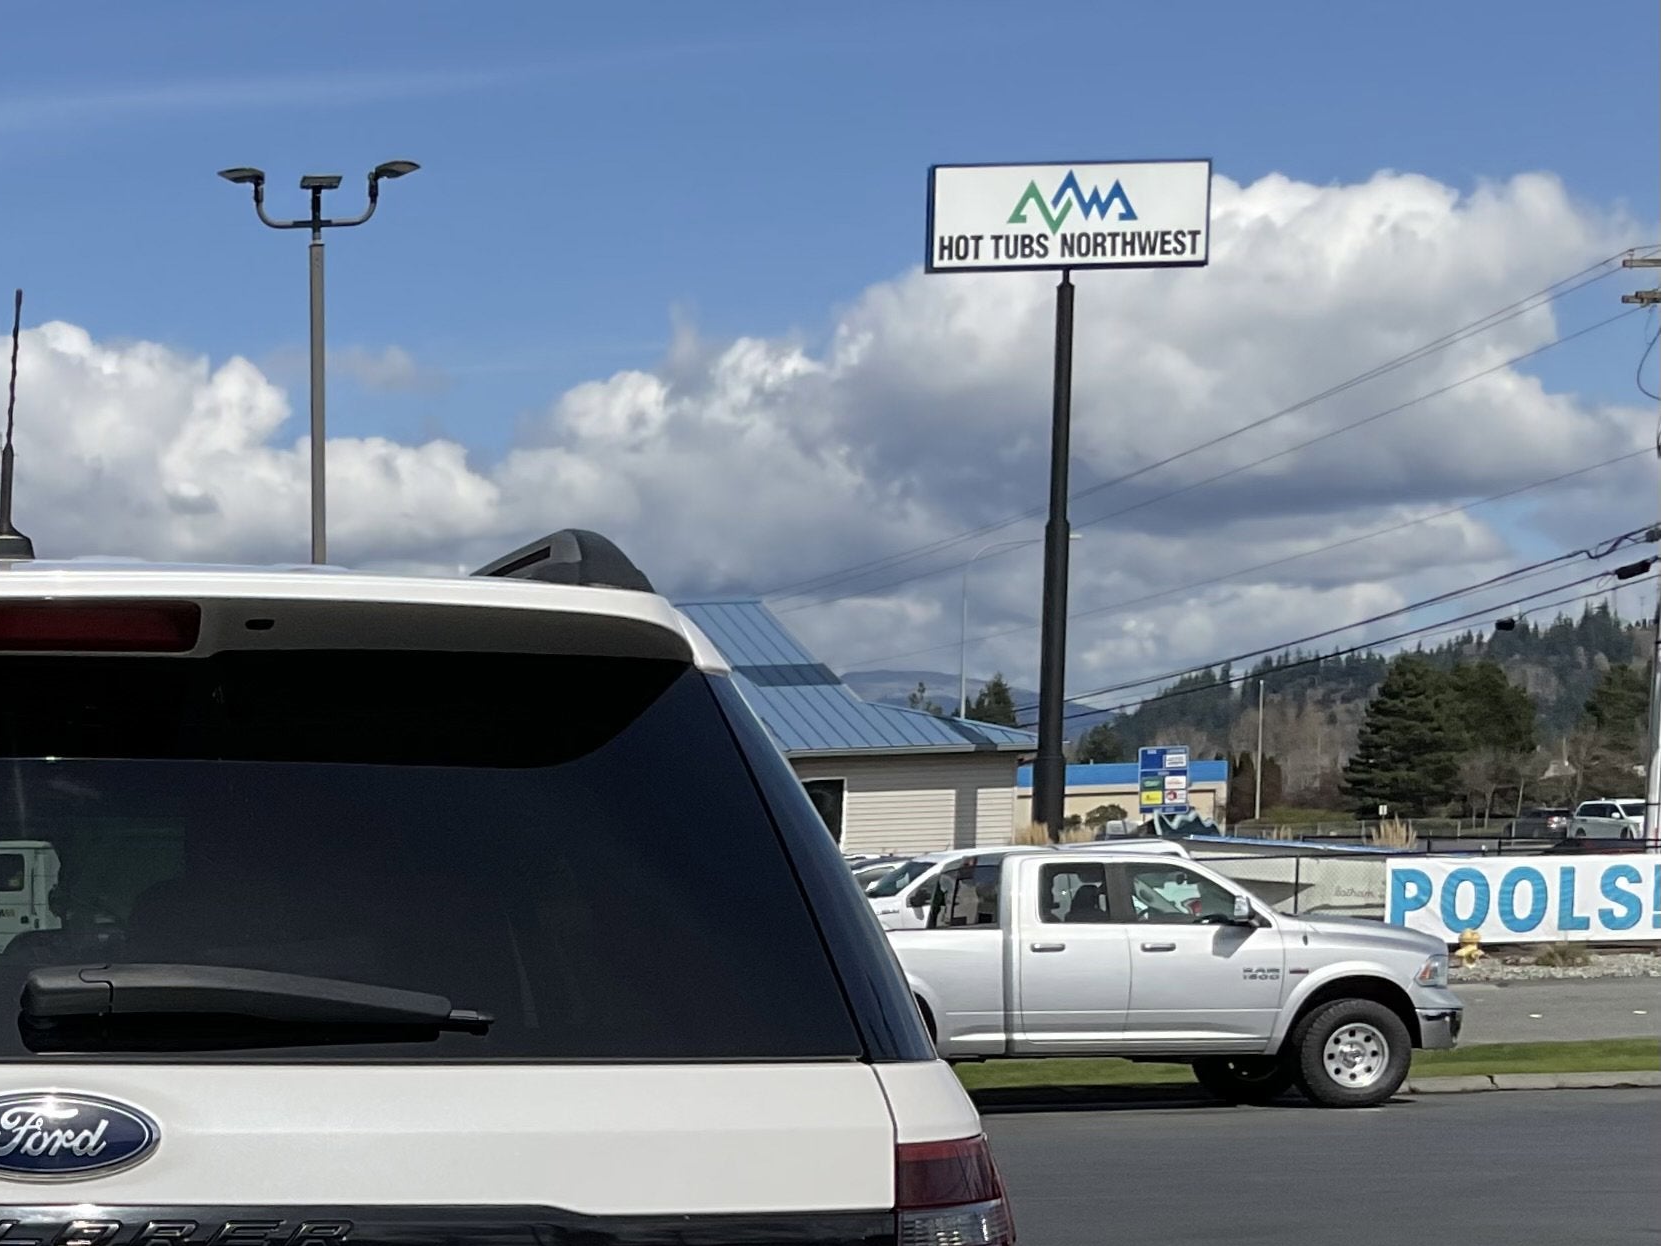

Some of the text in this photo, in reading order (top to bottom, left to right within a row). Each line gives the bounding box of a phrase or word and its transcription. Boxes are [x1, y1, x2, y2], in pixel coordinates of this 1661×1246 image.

[938, 230, 1201, 261] HOT TUBS NORTHWEST
